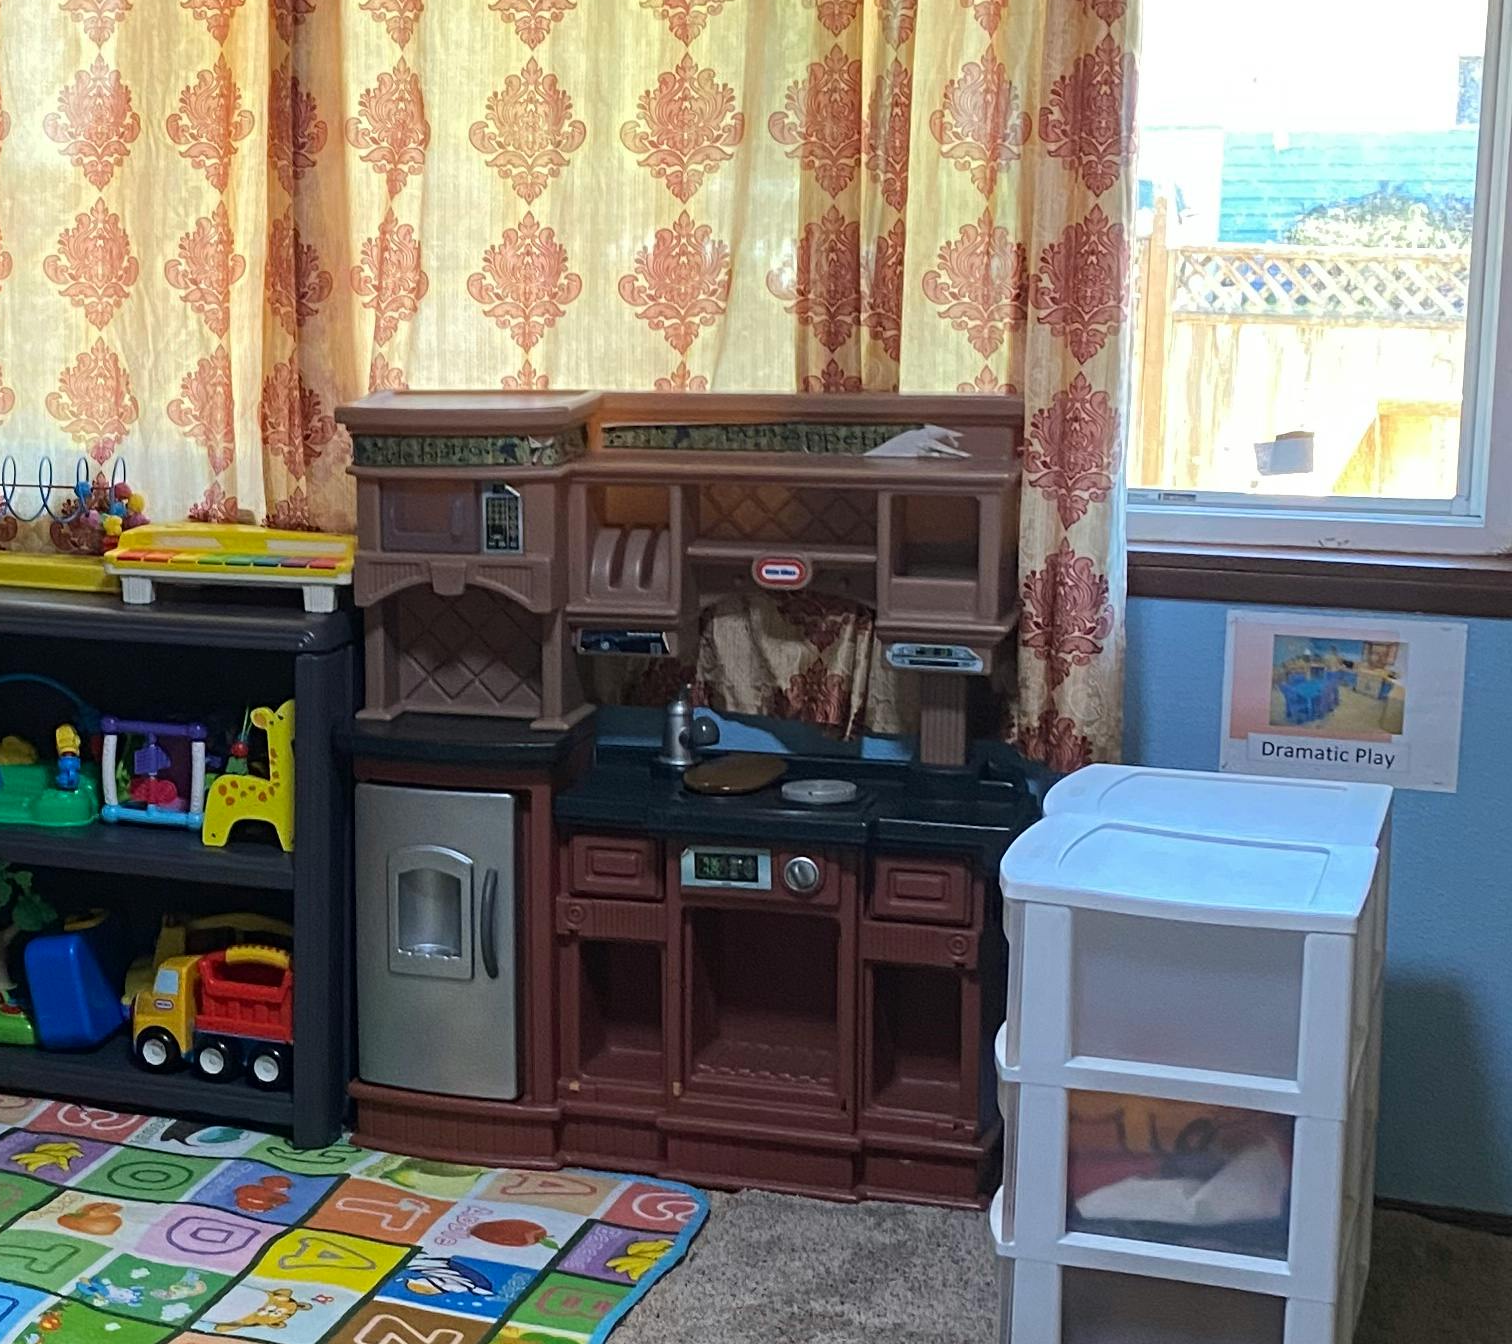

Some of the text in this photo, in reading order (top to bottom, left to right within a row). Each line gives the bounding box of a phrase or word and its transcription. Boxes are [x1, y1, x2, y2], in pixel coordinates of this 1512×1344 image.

[1261, 740, 1396, 770] Dramatic Play
[335, 1196, 431, 1233] T
[165, 1216, 262, 1256] D
[278, 1236, 377, 1272] A
